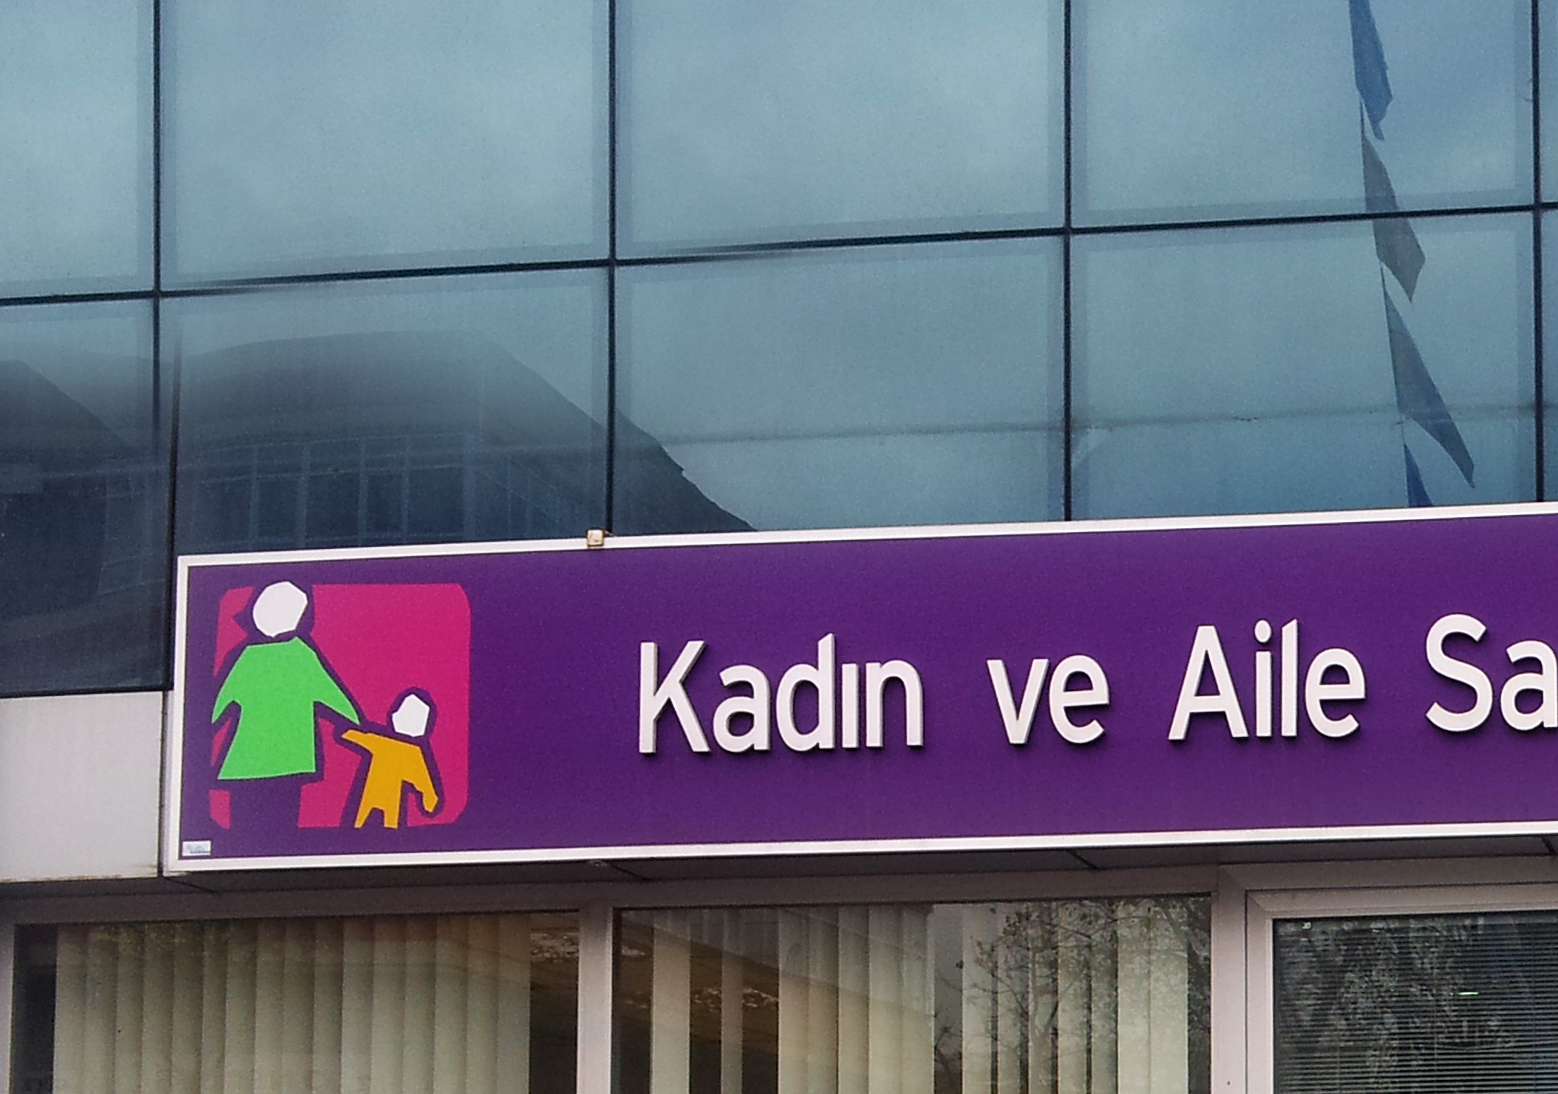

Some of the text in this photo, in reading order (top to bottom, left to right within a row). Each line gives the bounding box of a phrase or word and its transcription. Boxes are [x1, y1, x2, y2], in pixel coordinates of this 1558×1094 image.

[637, 632, 925, 756] Kadın
[986, 653, 1111, 746] ve
[1166, 618, 1368, 742] Aile
